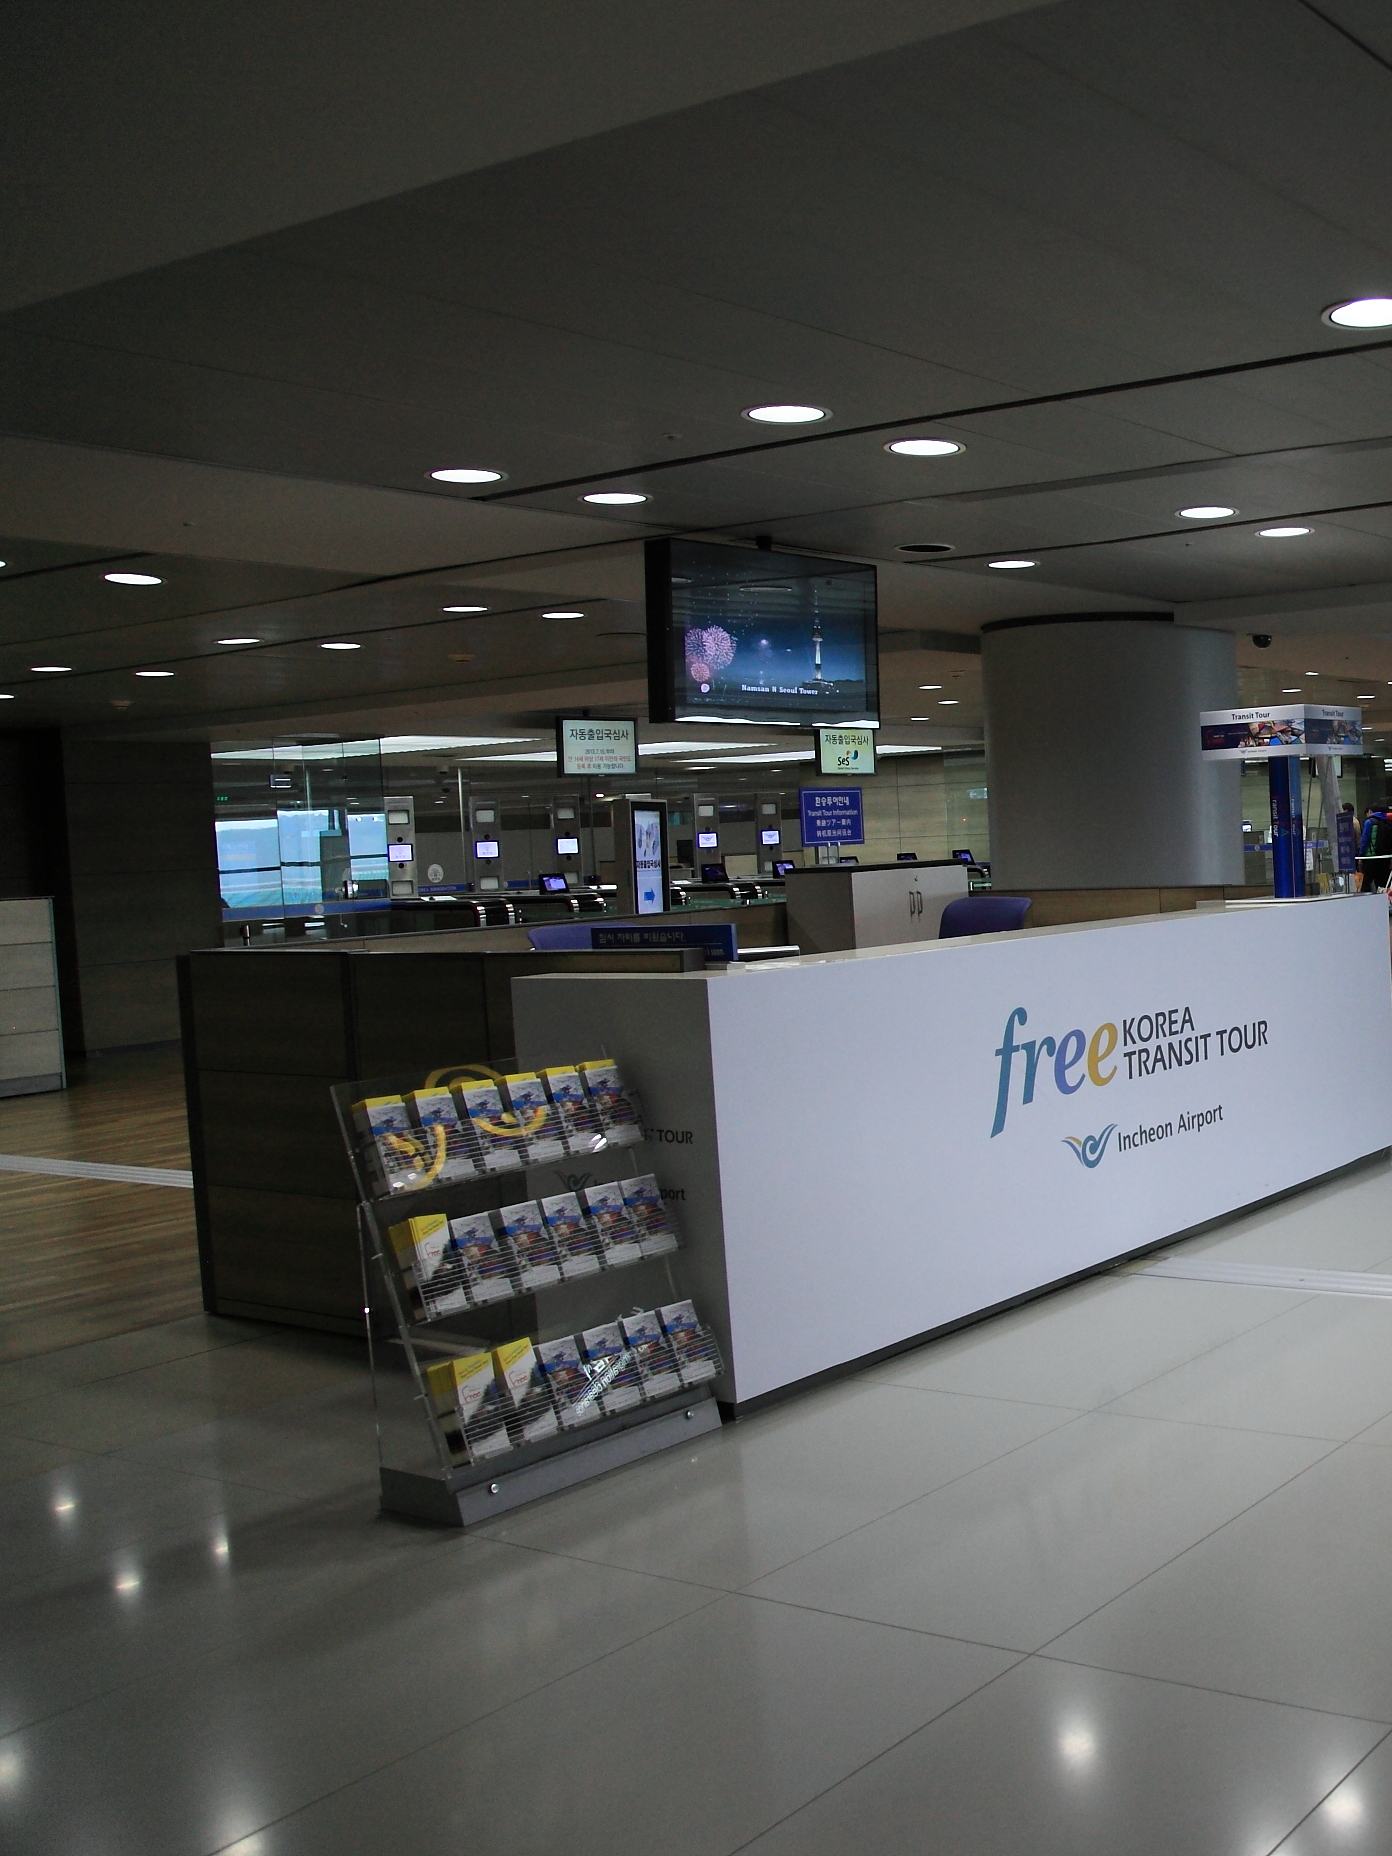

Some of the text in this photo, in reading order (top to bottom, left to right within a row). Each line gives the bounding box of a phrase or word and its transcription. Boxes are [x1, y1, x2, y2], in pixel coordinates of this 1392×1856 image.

[741, 684, 770, 693] Namsan
[779, 687, 798, 695] Seoul
[799, 686, 819, 696] Tower
[1232, 711, 1271, 721] Transit Tour
[1322, 709, 1335, 717] Transit
[569, 728, 629, 741] 자동출입국심사
[825, 734, 869, 746] 자동출입국심사
[1122, 1006, 1195, 1047] KOREA
[1123, 1020, 1269, 1080] TRANSIT TOUR
[990, 1006, 1118, 1139] free
[1117, 1104, 1224, 1152] Incheon Airport
[657, 1129, 693, 1145] TOUR
